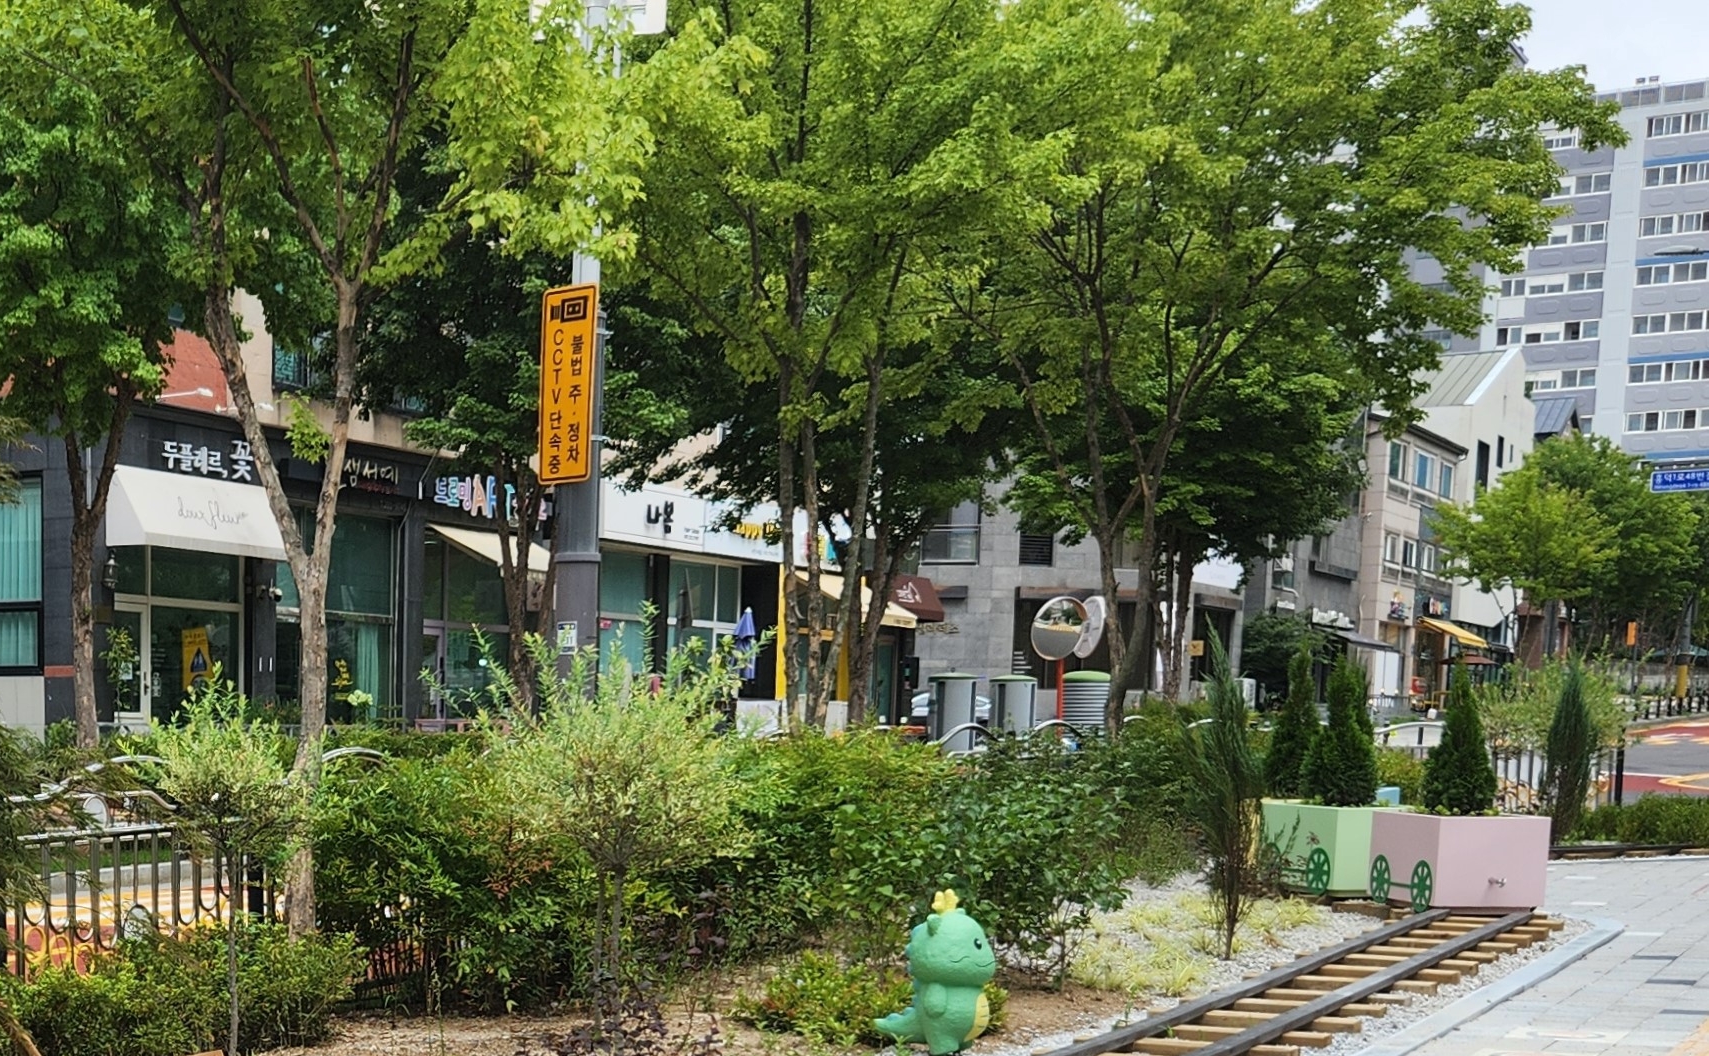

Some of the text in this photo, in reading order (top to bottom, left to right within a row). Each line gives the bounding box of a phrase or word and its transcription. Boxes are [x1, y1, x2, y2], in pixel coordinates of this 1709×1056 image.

[570, 333, 584, 376] 불법
[548, 328, 564, 474] CCTV 단속중
[229, 440, 253, 481] 꽃
[1655, 472, 1709, 484] 흥덕1로48번
